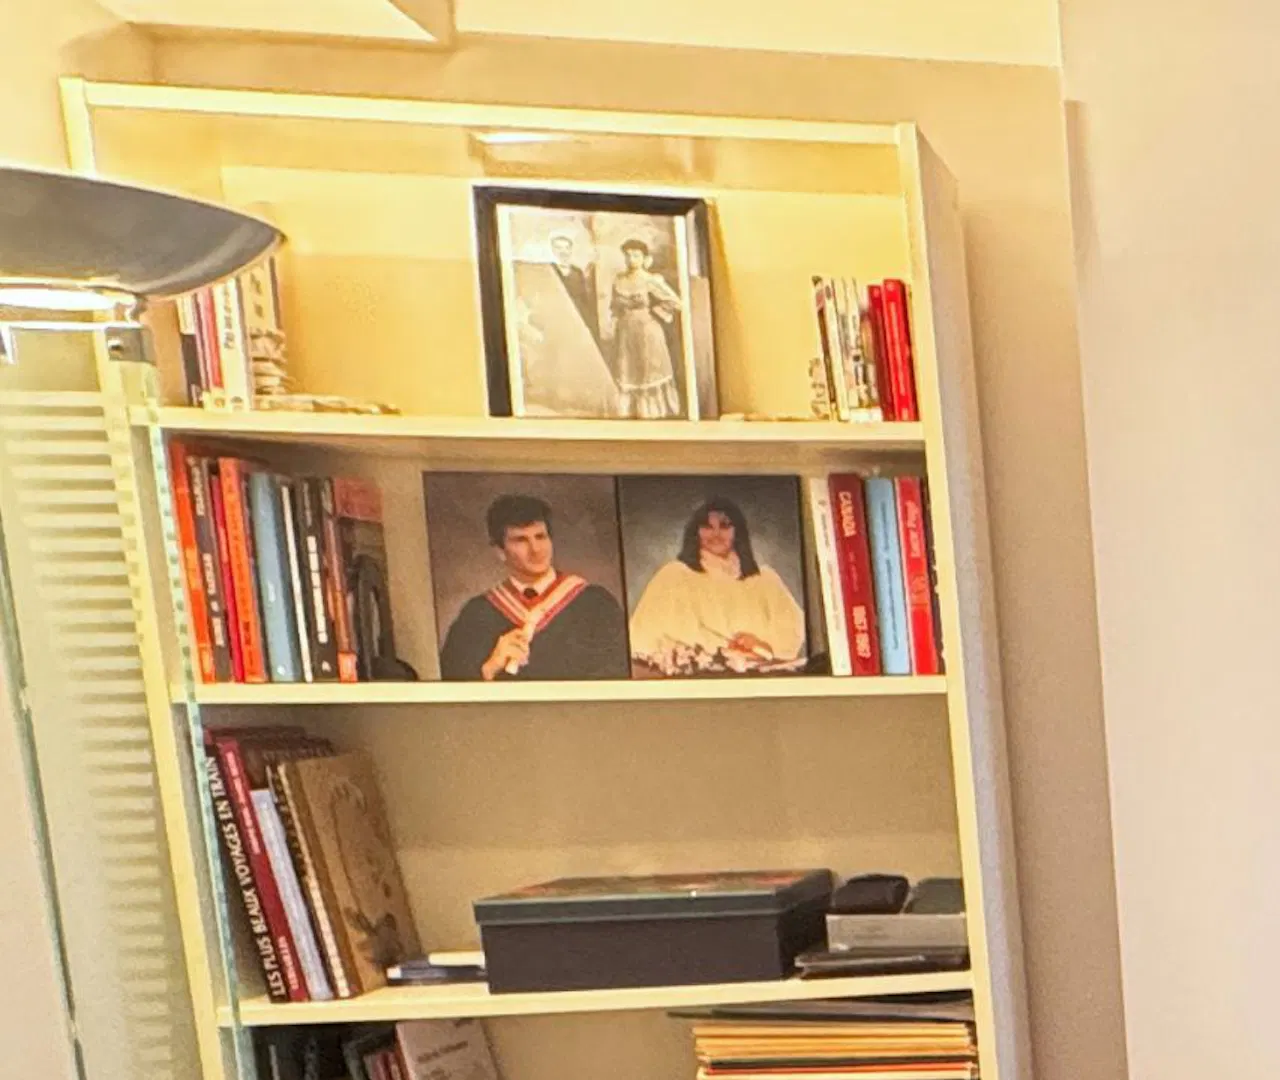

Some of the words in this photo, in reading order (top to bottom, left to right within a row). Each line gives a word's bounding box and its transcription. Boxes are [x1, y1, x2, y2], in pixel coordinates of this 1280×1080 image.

[838, 491, 857, 537] CANADA
[205, 757, 227, 798] TRAIN
[215, 800, 234, 820] EN
[222, 822, 253, 887] VOYAGES
[242, 888, 268, 934] BEAUX
[256, 936, 279, 971] PLUS
[266, 970, 286, 996] LES
